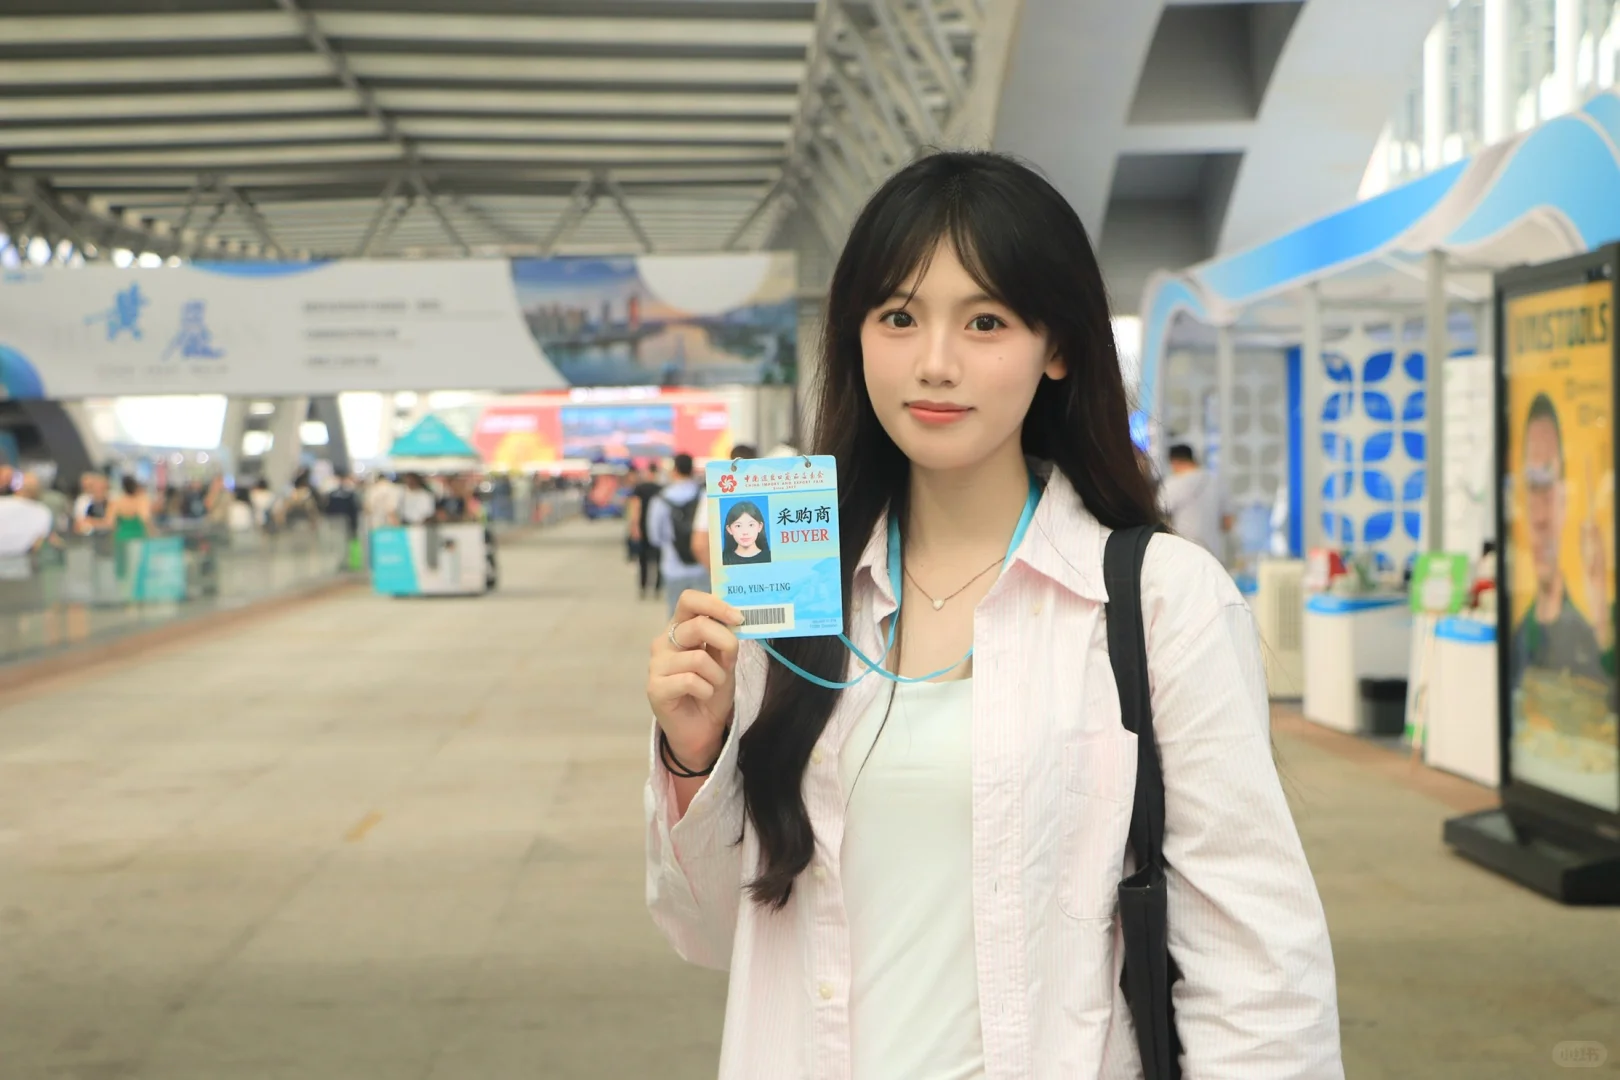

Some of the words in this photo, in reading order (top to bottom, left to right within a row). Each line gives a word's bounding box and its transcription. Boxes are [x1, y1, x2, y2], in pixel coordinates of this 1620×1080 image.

[776, 505, 831, 525] 采购商
[781, 528, 830, 543] BUYER
[727, 582, 791, 595] KUO,YUN-TING
